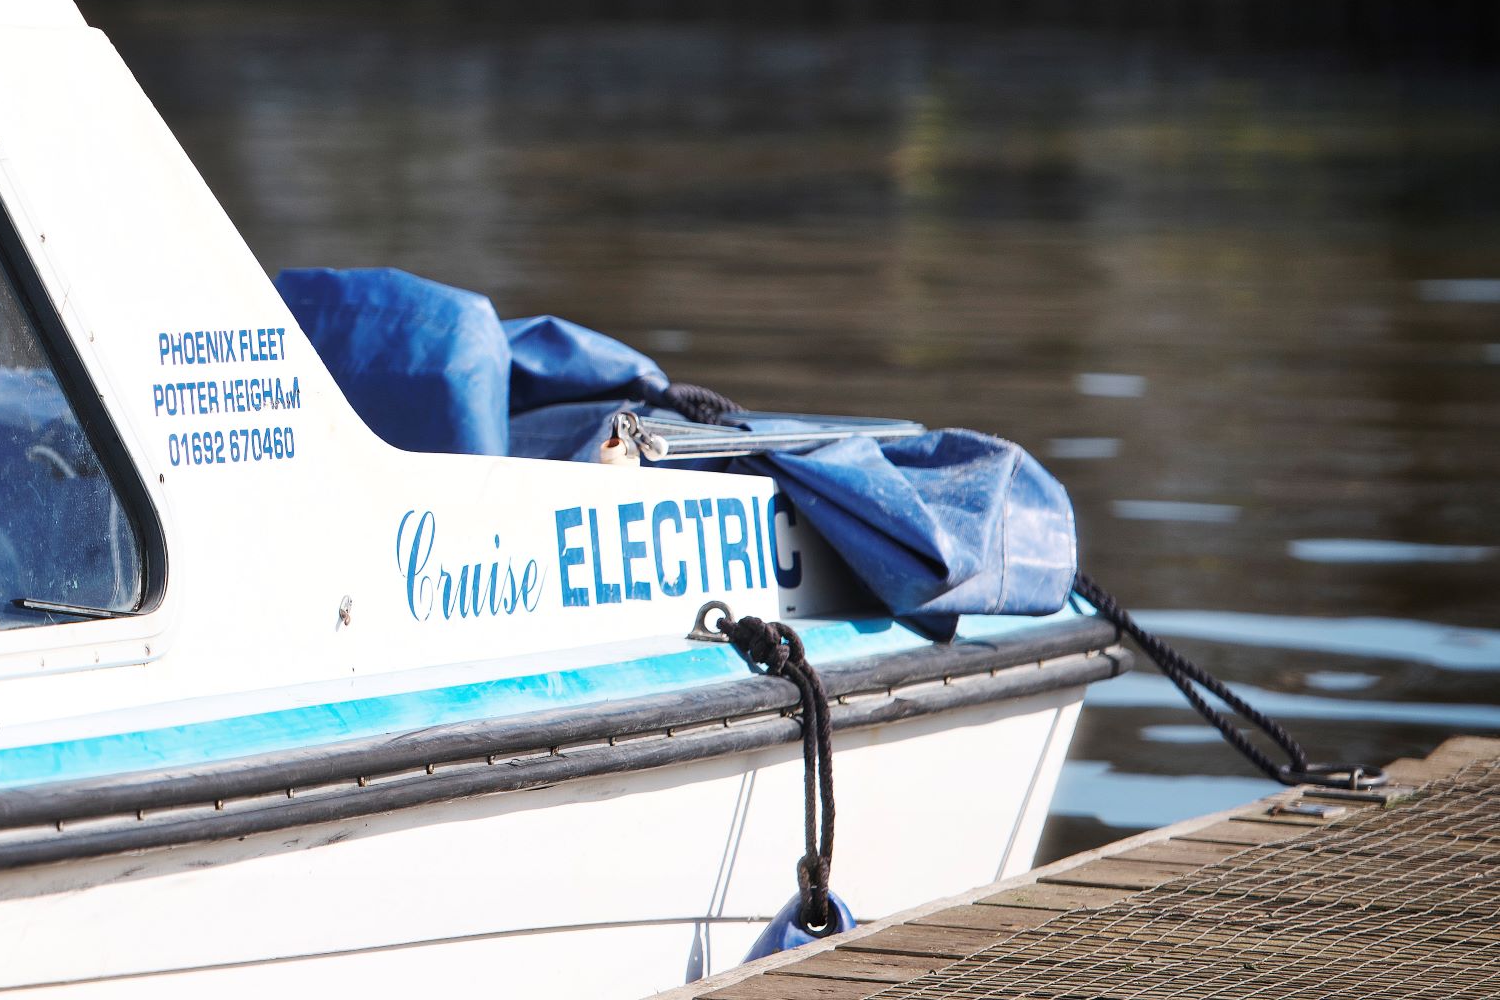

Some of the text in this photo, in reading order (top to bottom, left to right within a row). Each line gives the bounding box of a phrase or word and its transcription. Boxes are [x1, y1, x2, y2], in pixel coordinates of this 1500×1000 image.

[158, 328, 285, 365] PHOENIX FLEET
[153, 377, 301, 416] POTTER HEIGHAM
[168, 427, 295, 466] 01692 670460
[396, 492, 802, 621] Cruise ELECTRIC
